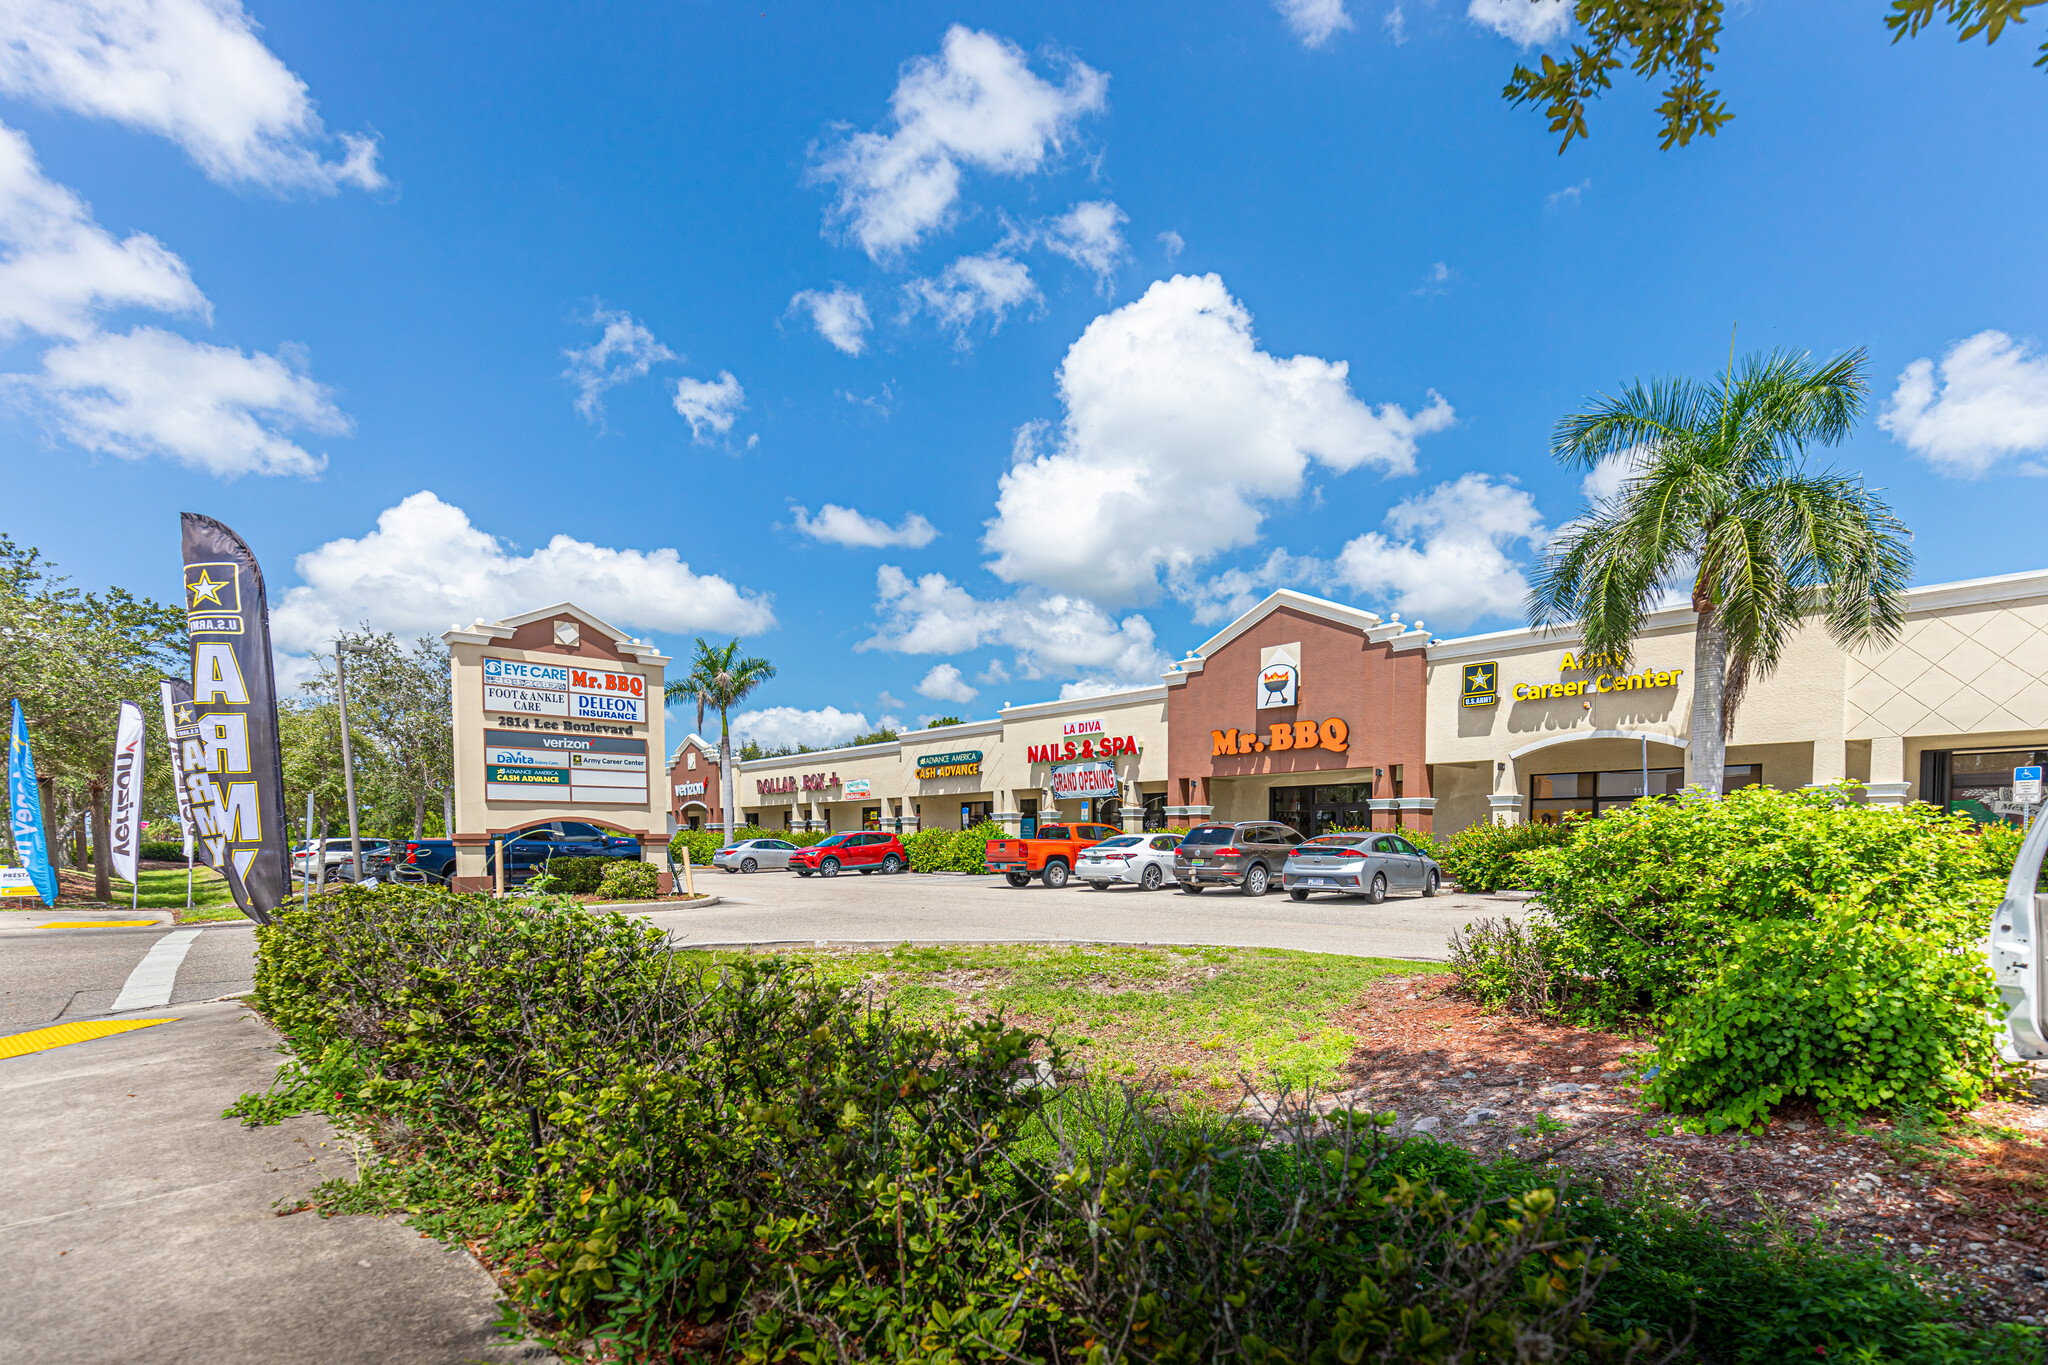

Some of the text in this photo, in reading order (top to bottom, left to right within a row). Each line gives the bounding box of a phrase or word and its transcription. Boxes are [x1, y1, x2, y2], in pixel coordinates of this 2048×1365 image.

[504, 664, 567, 681] EYE CARE
[572, 670, 602, 689] Mr.
[605, 674, 643, 697] BBQ
[1512, 668, 1683, 702] Career Center
[489, 688, 565, 704] FOOT & ANKLE
[579, 696, 637, 713] DELEON
[1465, 696, 1492, 705] U.S.ARMY
[513, 700, 541, 712] CARE
[579, 708, 638, 721] INSURANCE
[498, 716, 634, 735] 2814 Lee Boulevard
[1063, 720, 1101, 735] LA DIVA
[543, 737, 590, 750] verizon
[1211, 717, 1349, 756] Mr. BBQ
[497, 751, 534, 765] DaVita
[1028, 735, 1139, 764] NAILS & SPA
[583, 757, 601, 765] Army
[926, 752, 977, 765] ADVANCE AMERICA
[497, 774, 560, 783] CASH ADVANCE
[915, 763, 978, 780] CASH ADVANCE
[674, 780, 705, 797] verizon
[756, 776, 797, 795] DOLLAR
[803, 772, 827, 791] BOX
[1053, 768, 1115, 793] GRAND OPENING
